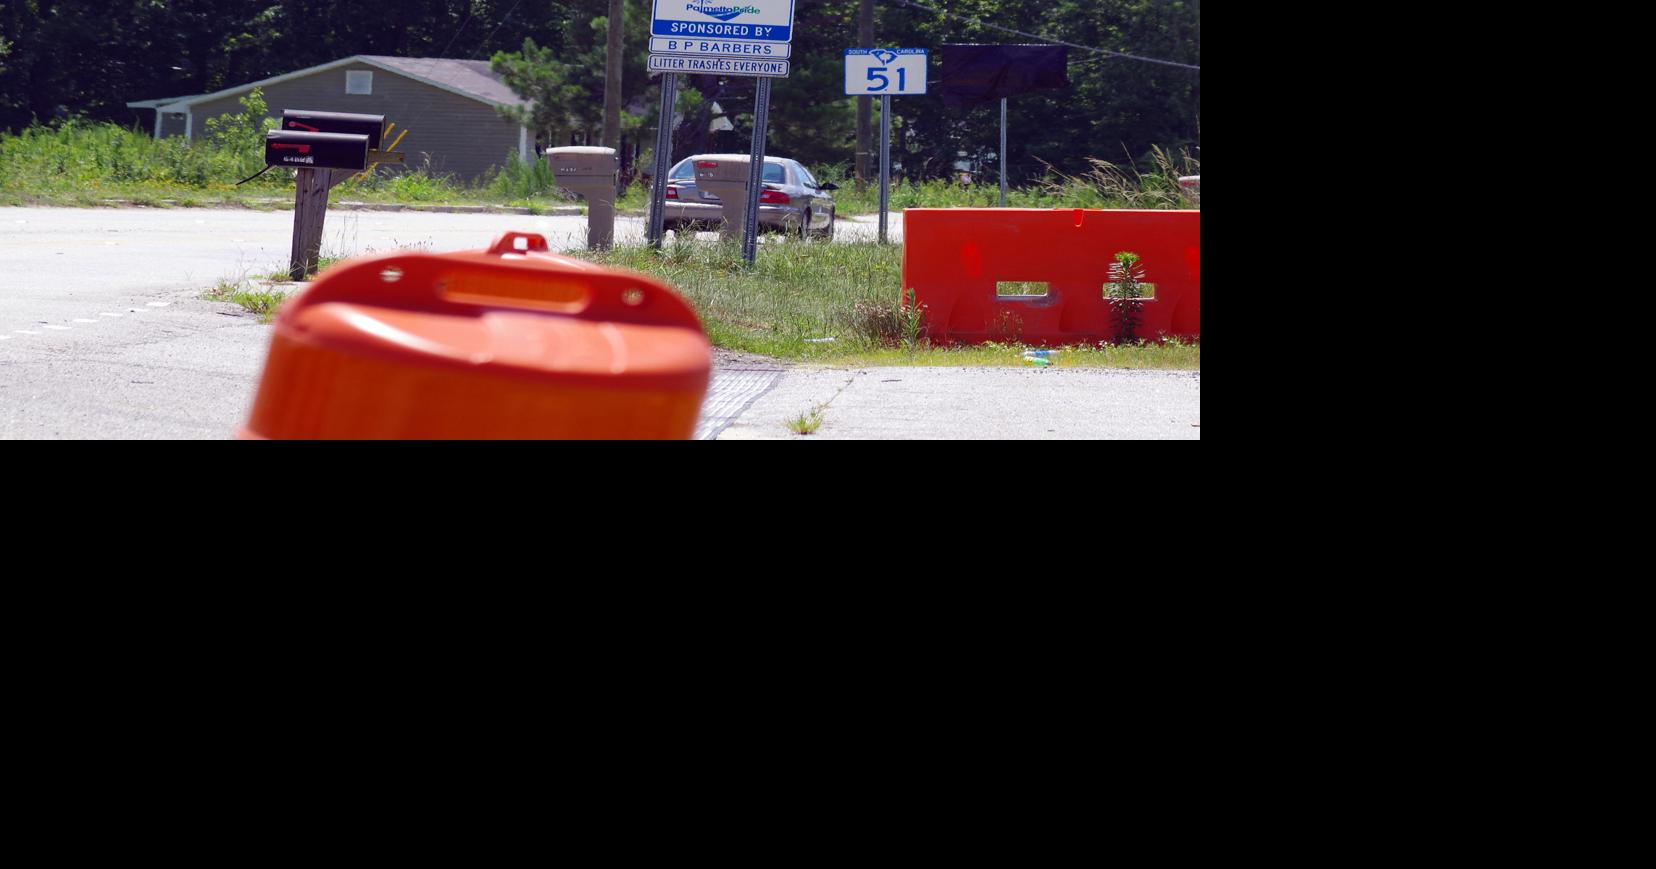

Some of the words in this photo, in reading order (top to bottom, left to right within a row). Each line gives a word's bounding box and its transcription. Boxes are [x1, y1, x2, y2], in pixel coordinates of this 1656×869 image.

[686, 3, 761, 15] PalmettoPride
[670, 22, 749, 36] SPONSORED
[755, 27, 773, 37] BY
[668, 40, 678, 50] B
[684, 41, 694, 51] P
[700, 42, 772, 55] BARBERS
[653, 58, 685, 68] LITTER
[688, 59, 731, 71] TRASHES
[733, 61, 784, 73] EVERYONE
[866, 67, 906, 92] 51
